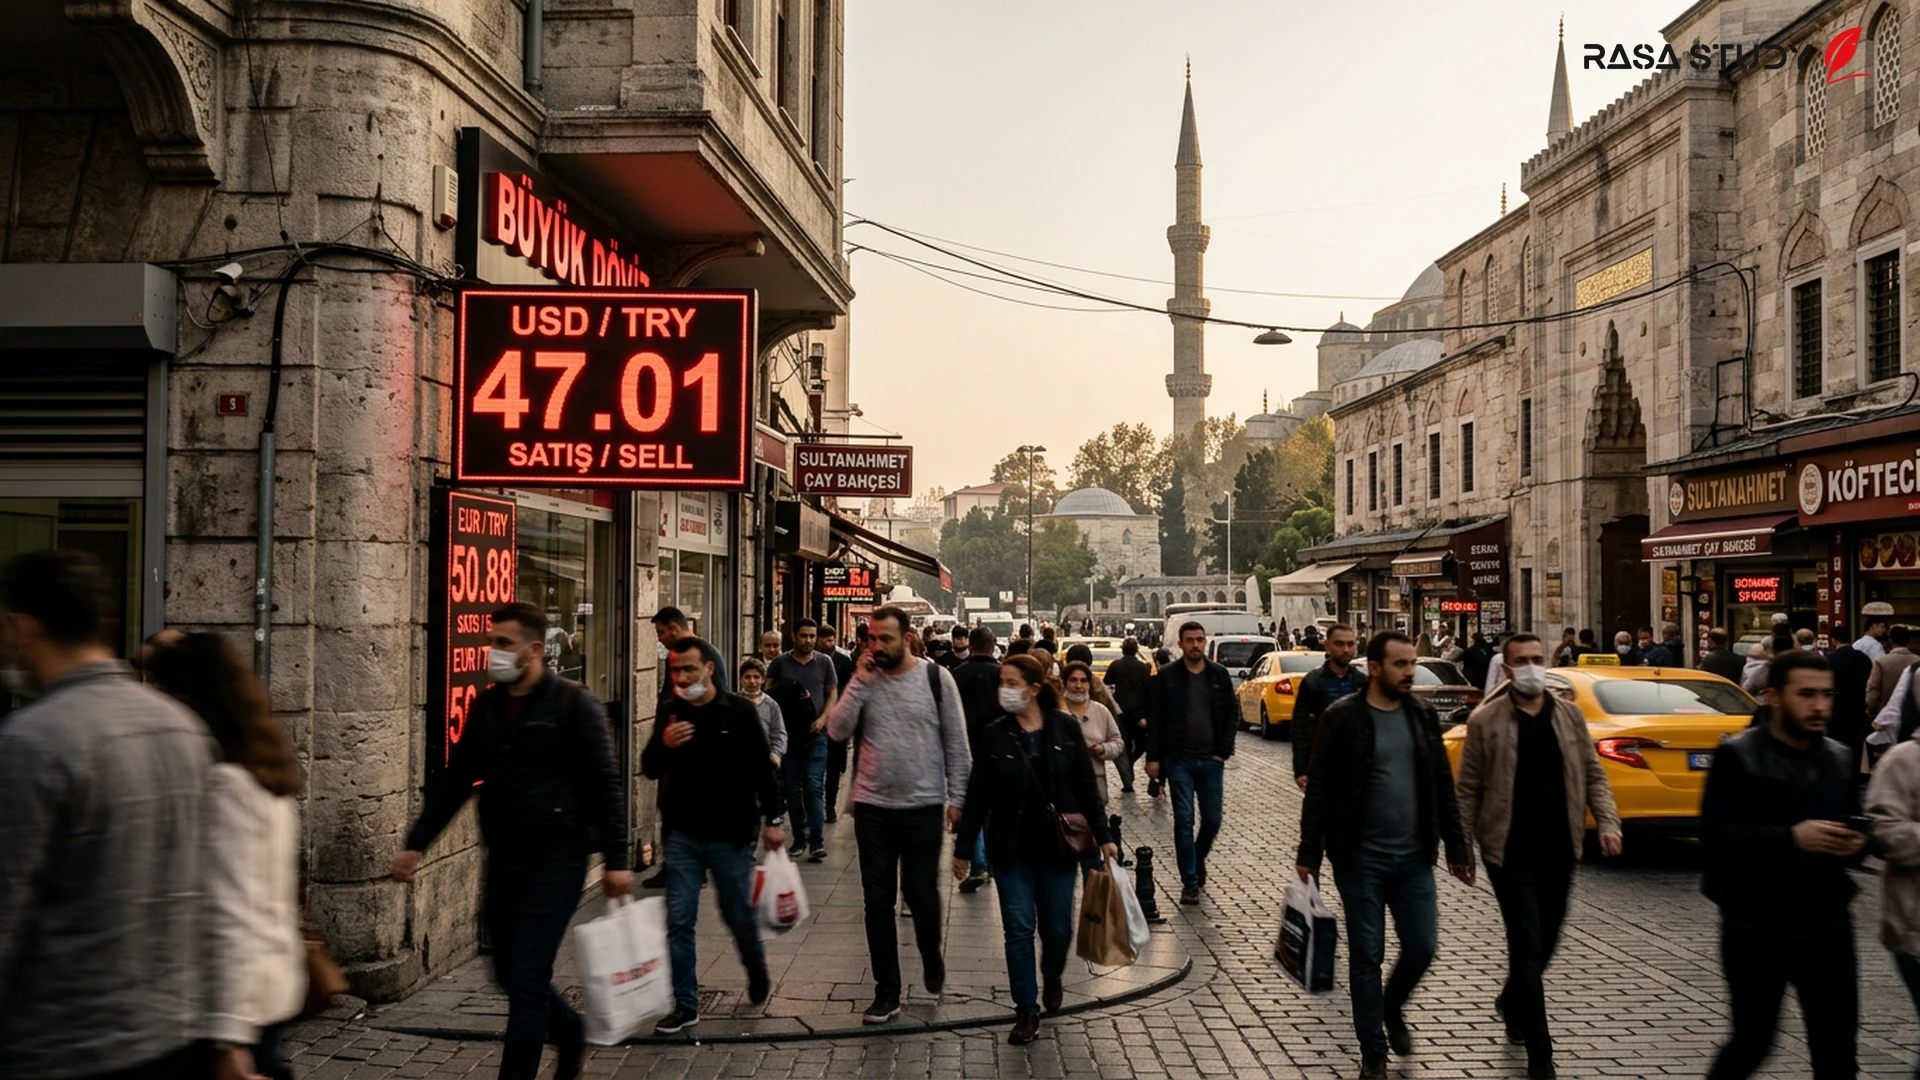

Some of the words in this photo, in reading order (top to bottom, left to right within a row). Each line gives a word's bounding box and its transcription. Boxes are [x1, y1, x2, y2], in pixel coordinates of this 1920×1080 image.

[497, 172, 586, 286] BÜYÜK
[592, 238, 650, 287] DÖVİ
[512, 305, 589, 336] USD
[599, 306, 612, 337] /
[622, 307, 696, 338] TRY
[473, 350, 719, 433] 47.01
[508, 442, 593, 474] SATIŞ
[600, 443, 611, 468] /
[618, 444, 693, 469] SELL
[799, 452, 908, 469] SULTANAHMET
[804, 472, 833, 491] ÇAY
[837, 472, 901, 492] BAHÇESİ
[1687, 470, 1786, 511] SULTANAHMET
[451, 544, 512, 603] 50.88
